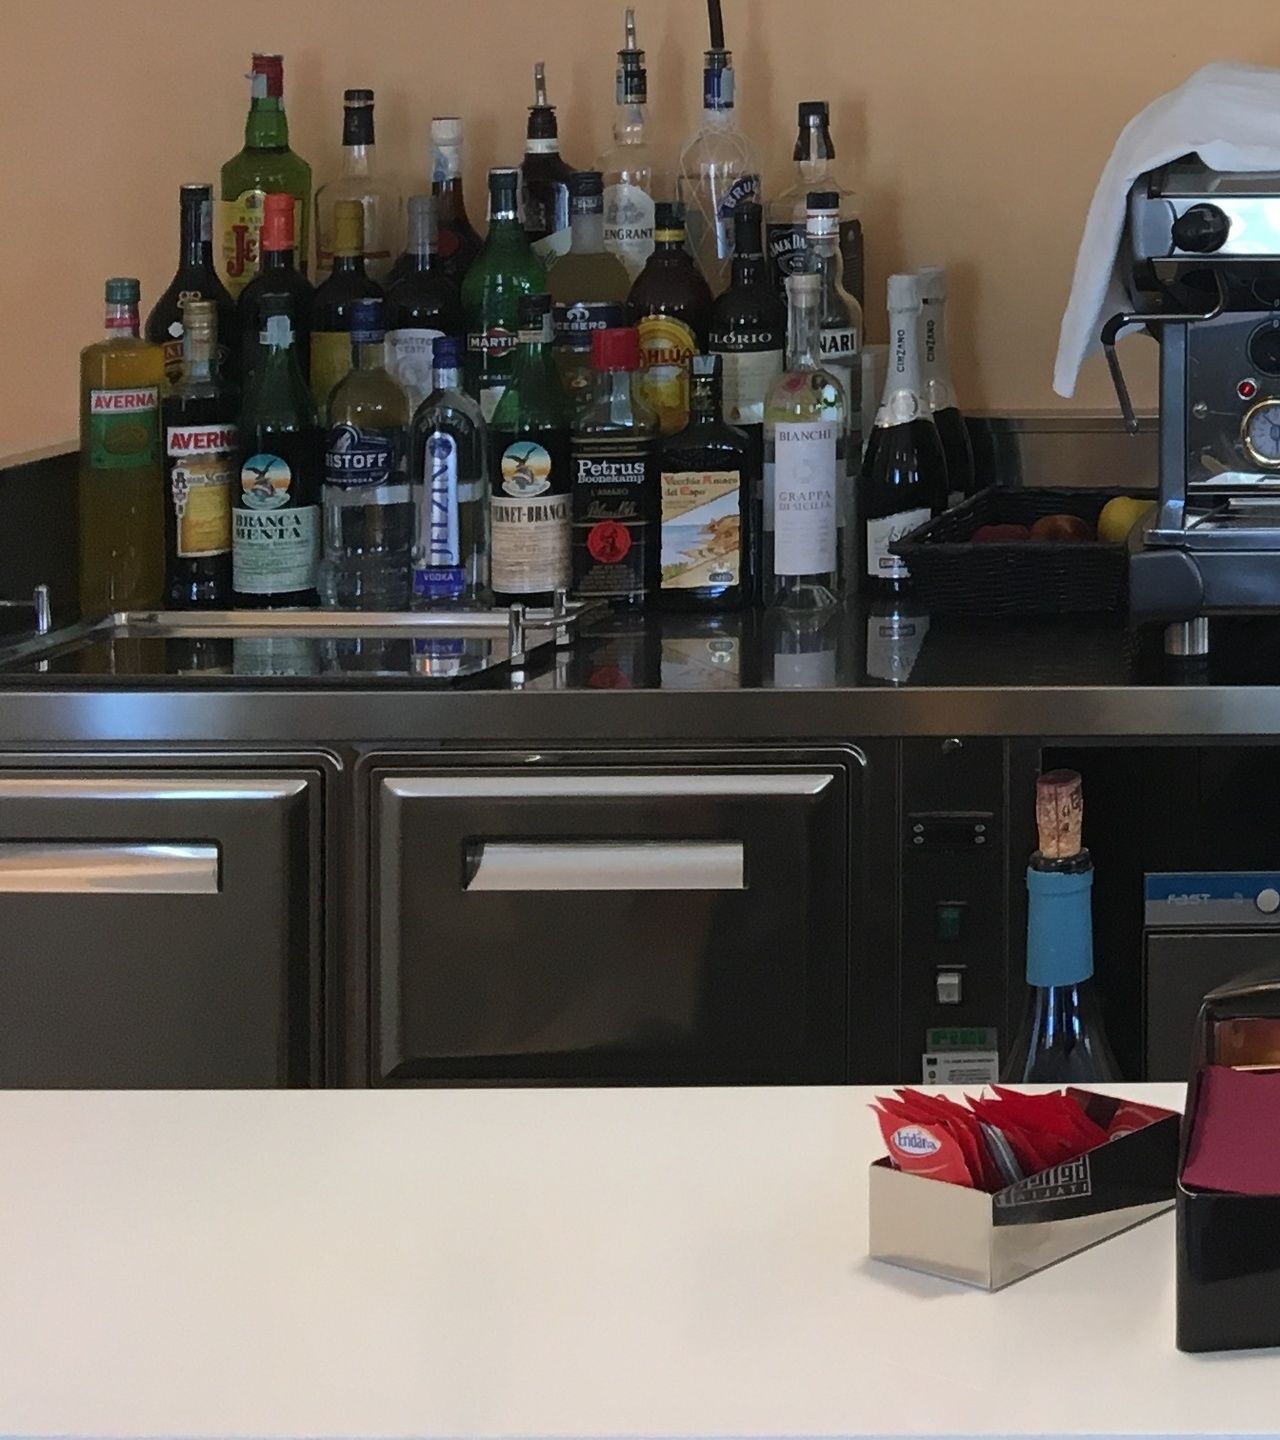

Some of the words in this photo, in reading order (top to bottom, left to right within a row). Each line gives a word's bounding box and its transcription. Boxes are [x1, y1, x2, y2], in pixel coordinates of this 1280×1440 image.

[603, 228, 653, 241] ENGRANT
[556, 321, 607, 330] CEBERG
[819, 333, 855, 353] NARI
[896, 329, 905, 373] CINZANO
[94, 393, 156, 409] AVERNA
[170, 429, 234, 450] AVERN
[779, 429, 831, 442] BIANCHI
[577, 459, 645, 475] Petrus
[778, 490, 831, 501] GRAPPA
[235, 514, 302, 528] BRANCA
[235, 527, 302, 539] MENTA
